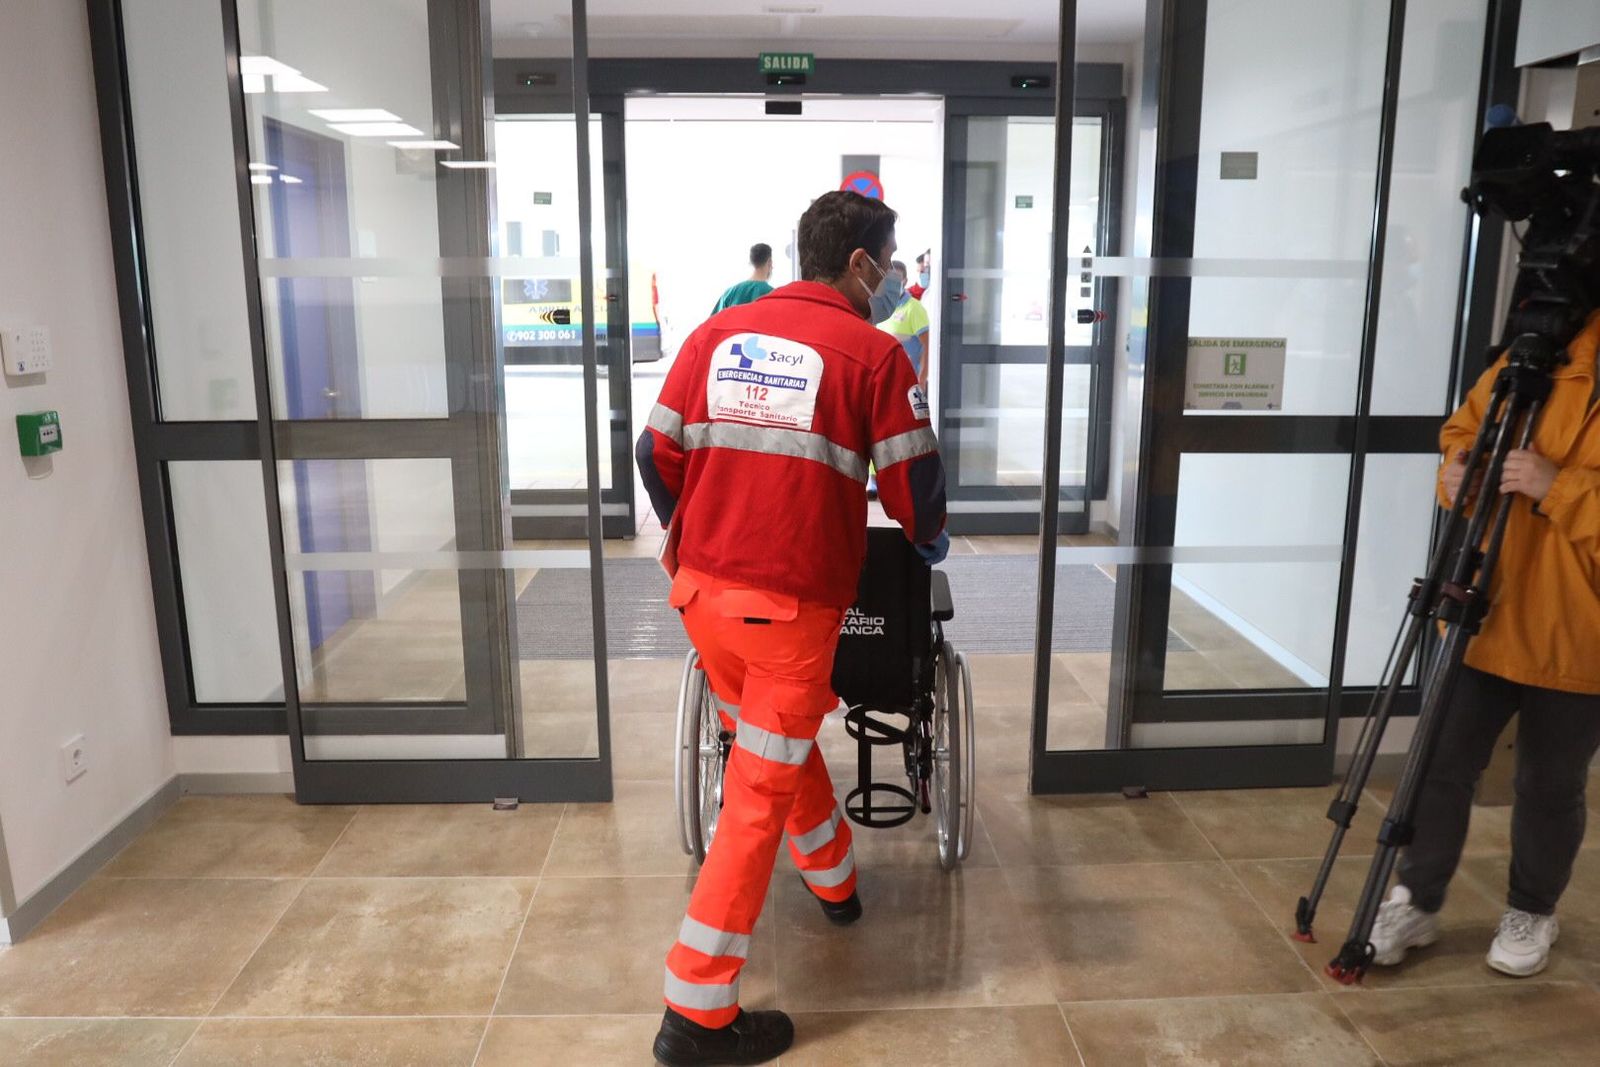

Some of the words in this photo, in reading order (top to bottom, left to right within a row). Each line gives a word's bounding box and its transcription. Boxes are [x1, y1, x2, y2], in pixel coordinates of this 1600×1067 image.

[764, 56, 809, 69] SALIDA
[517, 330, 536, 341] 902
[538, 330, 556, 341] 300
[558, 330, 576, 340] 061
[769, 351, 804, 366] Sacyl
[718, 370, 762, 384] EMERGENCIAS
[764, 376, 805, 389] SANITARIAS
[746, 385, 769, 401] 112
[717, 405, 757, 417] ansporte
[760, 411, 798, 423] Sanitario
[844, 607, 865, 616] AL
[842, 616, 885, 626] TARIO
[839, 626, 885, 635] ANCA
